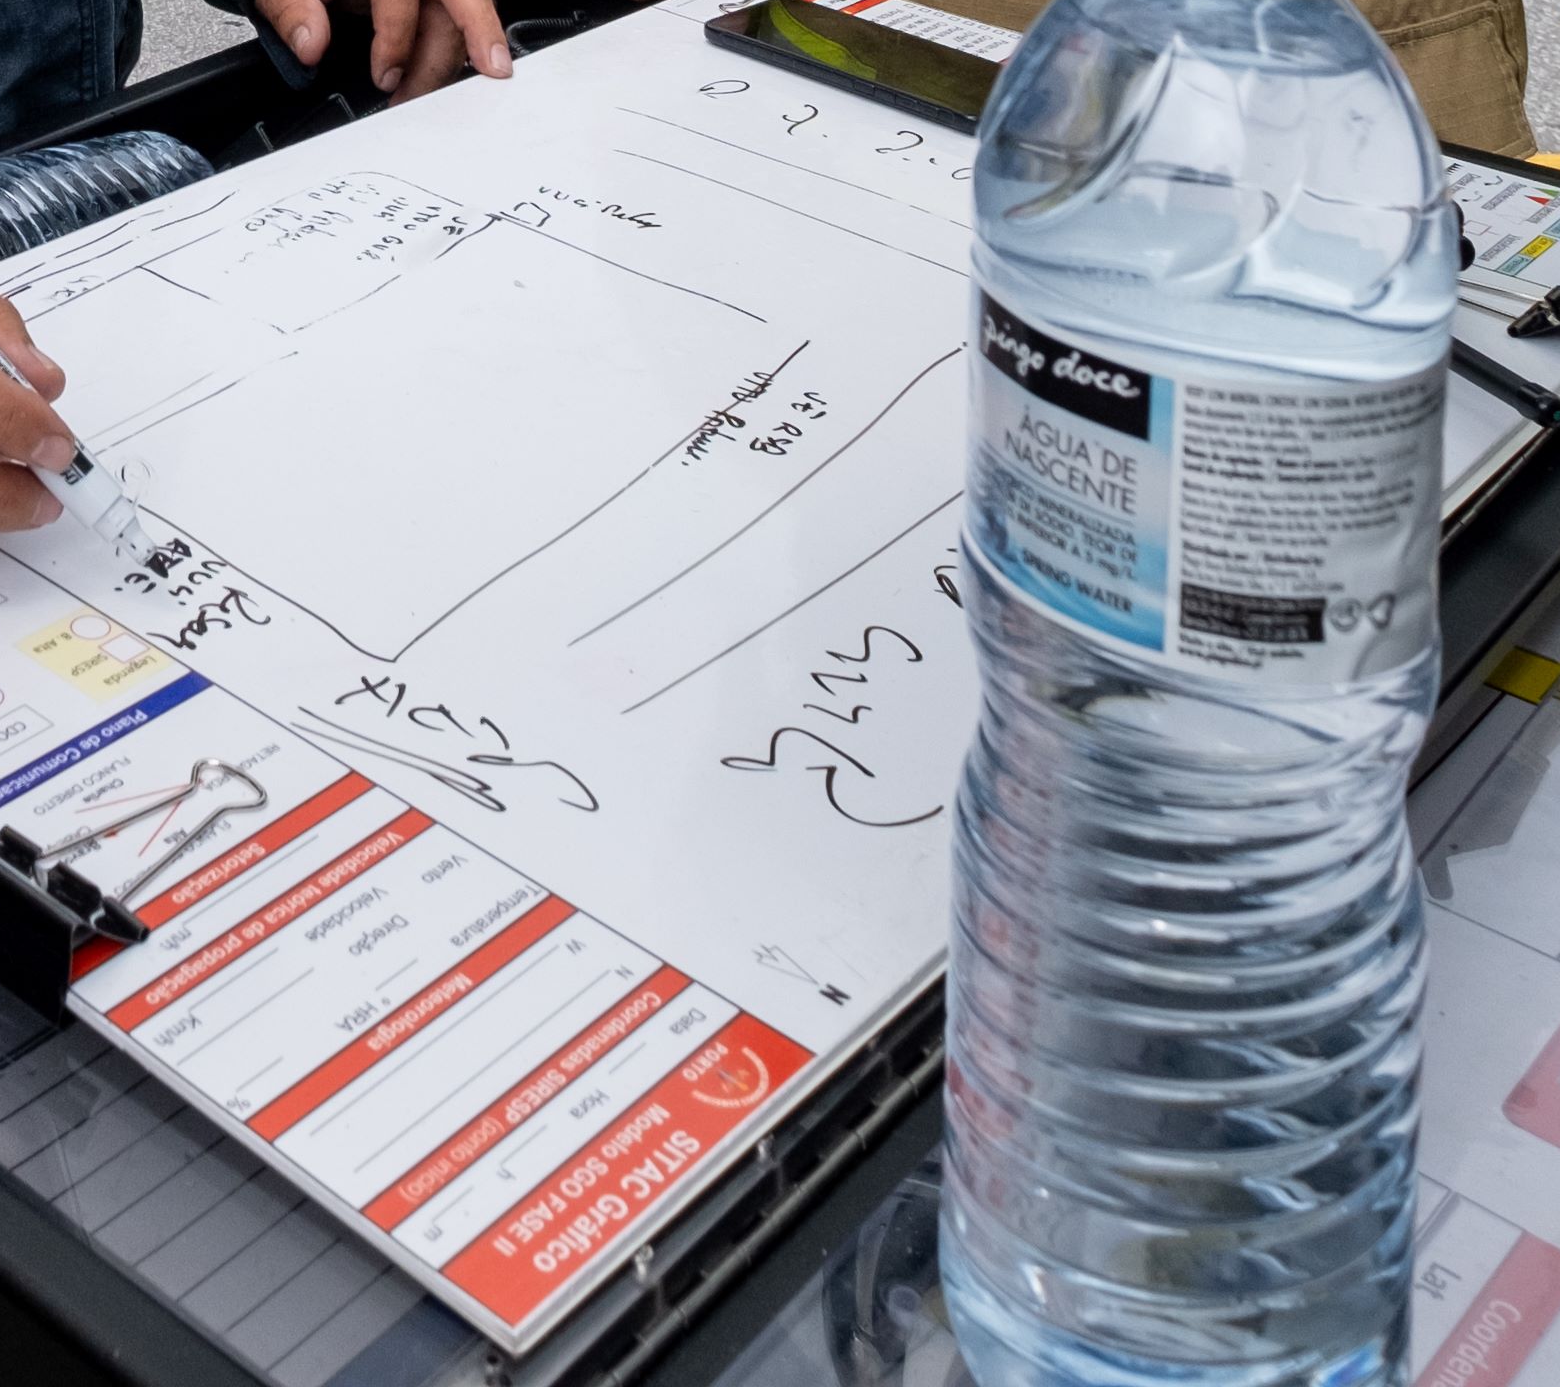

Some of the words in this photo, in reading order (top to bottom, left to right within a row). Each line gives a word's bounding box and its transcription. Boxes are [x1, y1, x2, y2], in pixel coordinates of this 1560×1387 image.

[984, 314, 1044, 375] pingo
[1052, 351, 1140, 398] doce
[1019, 407, 1091, 466] ÁGUA
[1102, 447, 1138, 484] DE
[1005, 430, 1138, 516] NASCENTE
[1022, 550, 1072, 589] SPRING
[1078, 580, 1134, 615] WATER
[31, 634, 59, 654] Alta
[103, 655, 157, 687] Legenda
[74, 733, 98, 755] de
[101, 709, 148, 743] Plano
[81, 756, 131, 790] FLANCO
[83, 777, 124, 805] Charlie
[33, 781, 83, 816] DIREITO
[162, 828, 190, 846] Alfa
[316, 829, 405, 888] Velocidade
[171, 843, 267, 905] Setorização
[421, 852, 469, 885] Vento
[261, 877, 315, 926] teórica
[304, 886, 390, 944] Velocidade
[450, 883, 546, 949] Temperatura
[159, 926, 193, 951] m/h
[233, 917, 259, 940] de
[347, 912, 410, 957] Direção
[565, 938, 588, 956] W
[143, 928, 233, 1008] propagação
[615, 964, 634, 981] N
[367, 972, 473, 1053] Meteorologia
[818, 982, 853, 1008] N
[152, 1014, 204, 1048] Km/h
[335, 1002, 379, 1033] HRA
[563, 990, 662, 1073] Coordenadas
[668, 1007, 709, 1037] Data
[679, 1041, 729, 1084] PORTO
[227, 1095, 252, 1112] %
[500, 1065, 568, 1129] SIRESP
[569, 1088, 612, 1120] Hora
[446, 1115, 507, 1165] (ponto
[603, 1100, 671, 1164] Modelo
[398, 1157, 453, 1204] início)
[556, 1154, 608, 1199] SGO
[614, 1128, 700, 1200] SITAC
[517, 1185, 558, 1235] FASE
[493, 1233, 512, 1258] II
[532, 1193, 627, 1274] Gráfico
[1413, 1262, 1462, 1301] Lat
